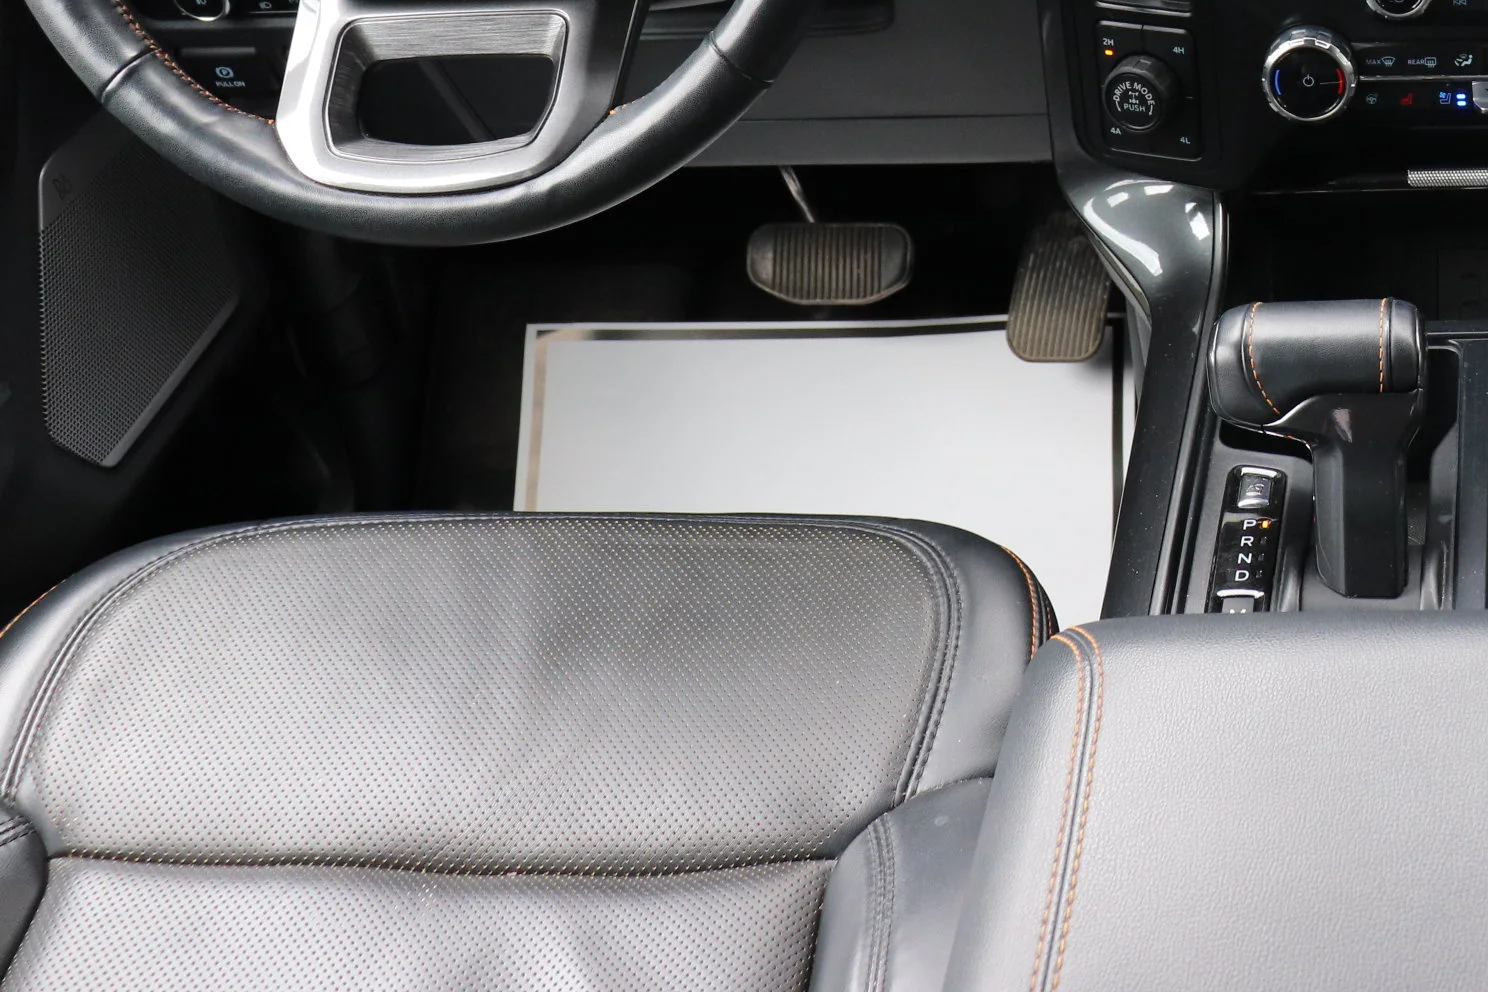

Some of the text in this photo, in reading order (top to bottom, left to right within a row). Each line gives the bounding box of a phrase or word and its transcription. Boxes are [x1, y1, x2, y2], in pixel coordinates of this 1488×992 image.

[1102, 38, 1115, 47] 2H
[1172, 46, 1185, 55] 4H
[1112, 81, 1155, 105] DRIVE MODE
[1123, 103, 1146, 113] PUSH
[1110, 127, 1122, 136] 4A
[1180, 136, 1191, 145] 4L
[1243, 519, 1257, 530] P
[1240, 536, 1254, 547] R
[1237, 553, 1253, 564] N
[1234, 570, 1250, 582] D
